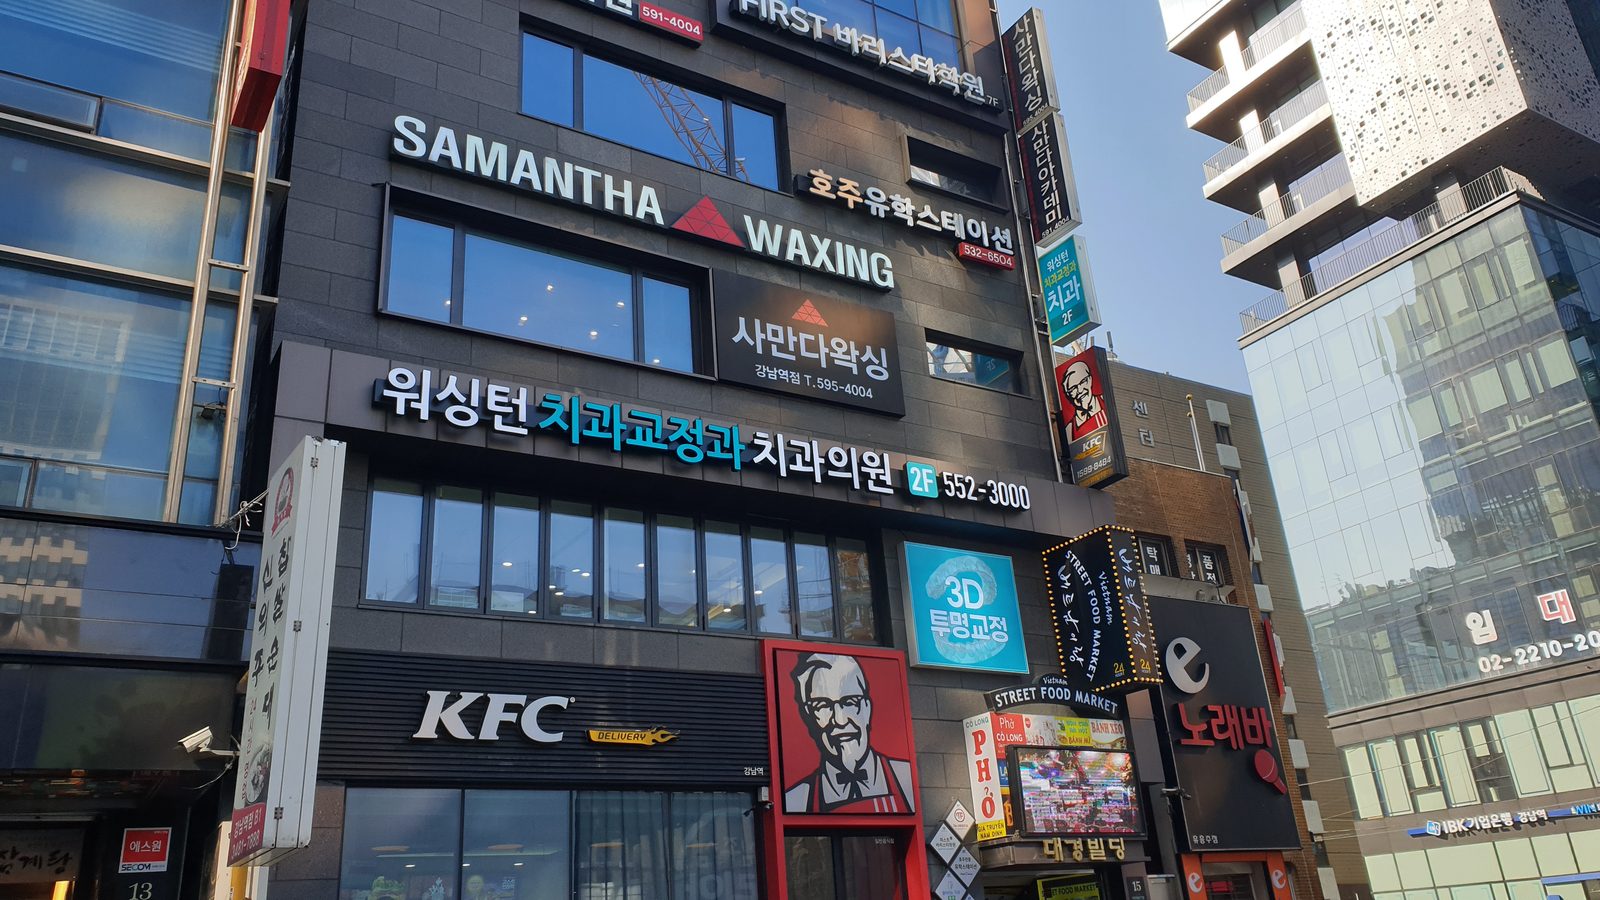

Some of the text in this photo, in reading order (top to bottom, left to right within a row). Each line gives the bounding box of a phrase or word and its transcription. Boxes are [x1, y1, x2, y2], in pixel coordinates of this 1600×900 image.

[642, 6, 701, 35] 591-4004
[833, 22, 986, 105] 바리스타학원
[985, 95, 999, 106] 7F
[1012, 15, 1043, 111] 사만다왁싱
[393, 115, 665, 226] SAMANTHA
[1031, 119, 1063, 225] 사만다아카데미
[743, 213, 896, 289] WAXING
[963, 244, 1013, 267] 532-6504
[1046, 249, 1070, 273] 워싱턴
[1044, 261, 1077, 288] 치과교정과
[1047, 274, 1081, 312] 치과
[1061, 309, 1074, 326] 2F
[731, 316, 890, 381] 사만다왁싱
[754, 364, 874, 399] 강남역점 T.595-4004
[1132, 400, 1155, 447] 센터
[382, 367, 1031, 510] 워싱턴 치과교정과 치과의원 2F 552-3000
[1082, 435, 1102, 452] KFC
[944, 576, 984, 610] 3D
[1098, 570, 1113, 626] Vietnam
[1536, 588, 1577, 625] 대
[251, 554, 274, 688] 신의주
[929, 608, 1010, 643] 투명교정
[1064, 549, 1102, 682] STREET FOOD MARKET
[1113, 662, 1125, 675] 24
[1139, 658, 1151, 672] 24
[1165, 636, 1210, 694] e
[1042, 676, 1068, 686] Vietnam
[995, 686, 1118, 715] STREET FOOD MARKET
[412, 690, 569, 743] KFC
[974, 716, 990, 727] LONG
[597, 732, 647, 742] DELIVERY
[1006, 733, 1023, 742] LONG
[743, 766, 764, 776] 강남역
[1442, 808, 1549, 834] IBK기업은행 강남역
[129, 839, 162, 853] 에스원
[1043, 837, 1126, 862] 대경빌딩
[121, 863, 151, 871] SECOM
[1271, 869, 1286, 889] e
[128, 882, 153, 900] 13
[1131, 881, 1142, 892] 15
[1188, 872, 1203, 893] e
